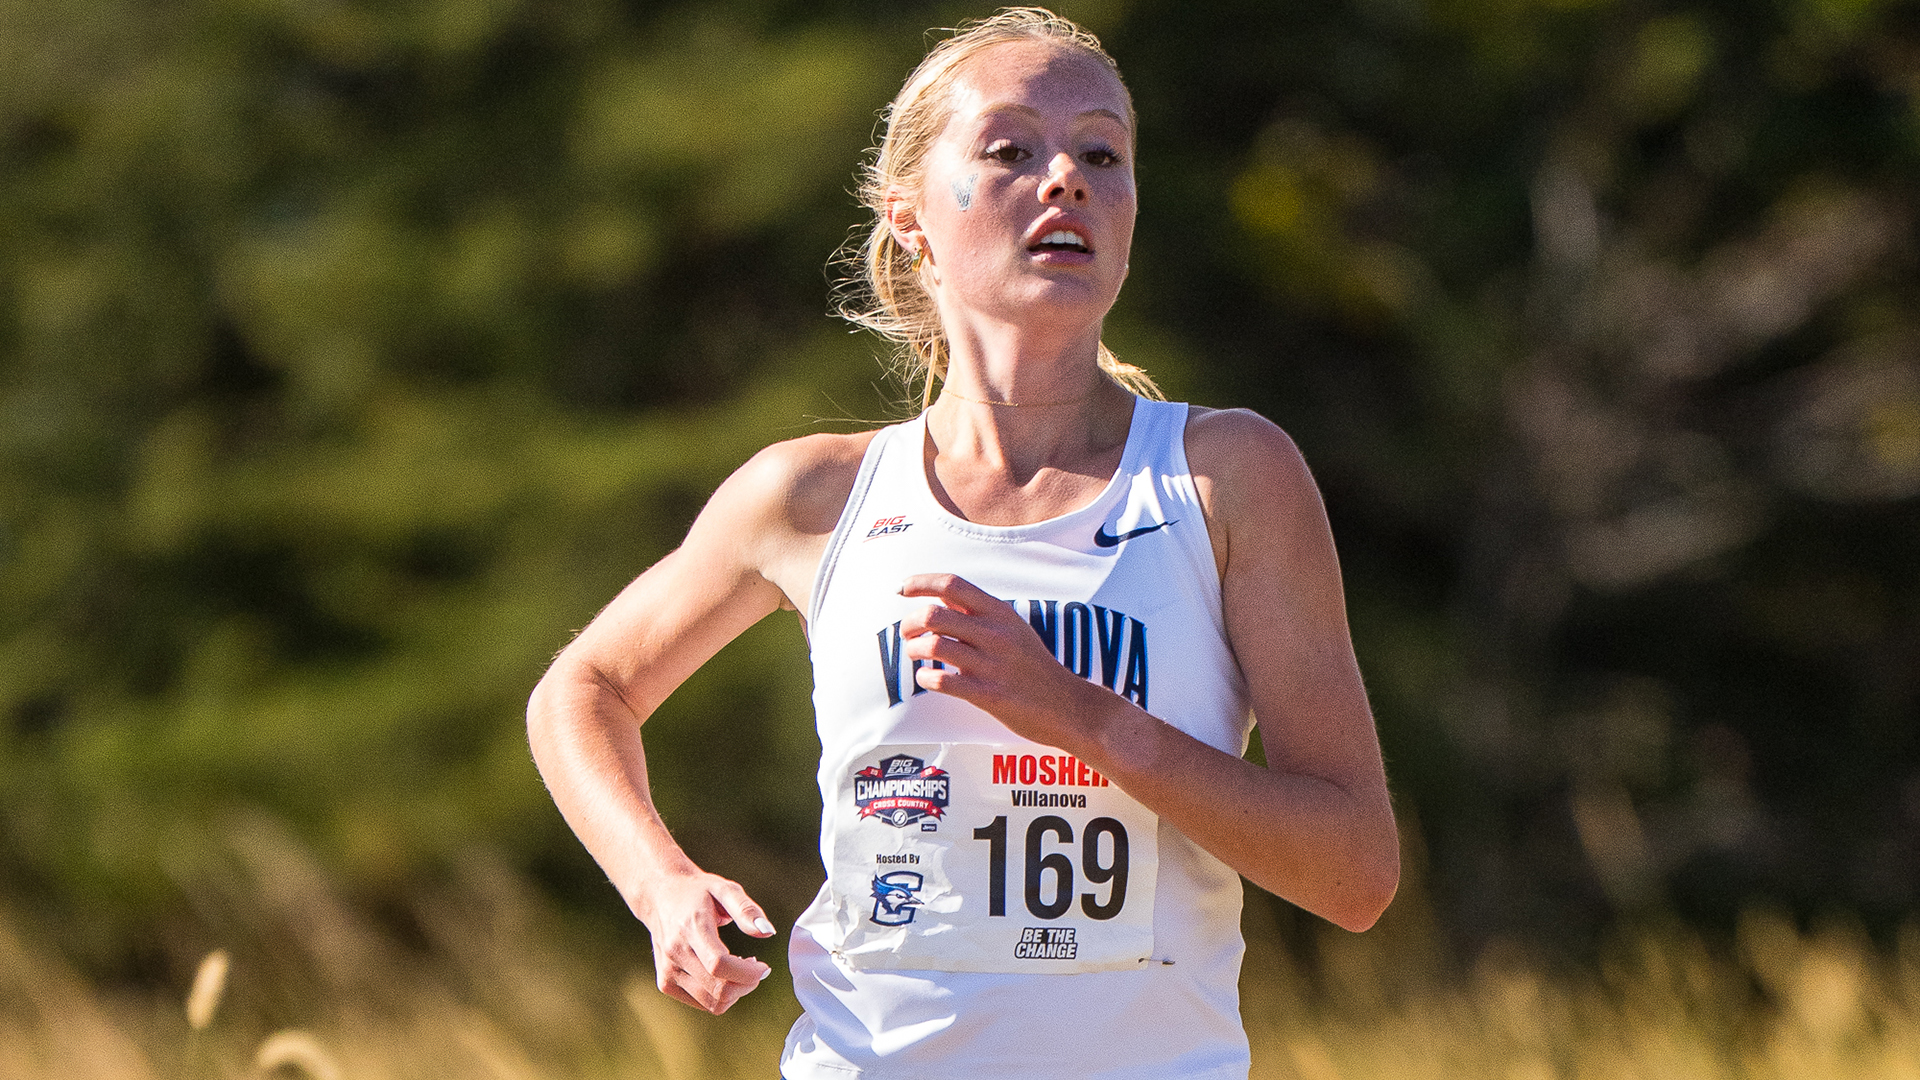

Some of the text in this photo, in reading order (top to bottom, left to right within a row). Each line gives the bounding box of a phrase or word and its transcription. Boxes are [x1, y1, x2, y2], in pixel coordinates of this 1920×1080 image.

[873, 515, 906, 528] BIG
[866, 523, 913, 538] EAST
[887, 766, 920, 774] EAST
[891, 759, 914, 767] BIG
[856, 780, 947, 801] CHAMPIONSHIPS
[873, 799, 929, 809] CROSS COUNTRY
[1011, 790, 1087, 809] Villanova
[876, 854, 920, 865] Hosted By
[972, 815, 1129, 920] 169
[1022, 928, 1075, 944] BE THE
[1015, 942, 1077, 959] CHANGE
